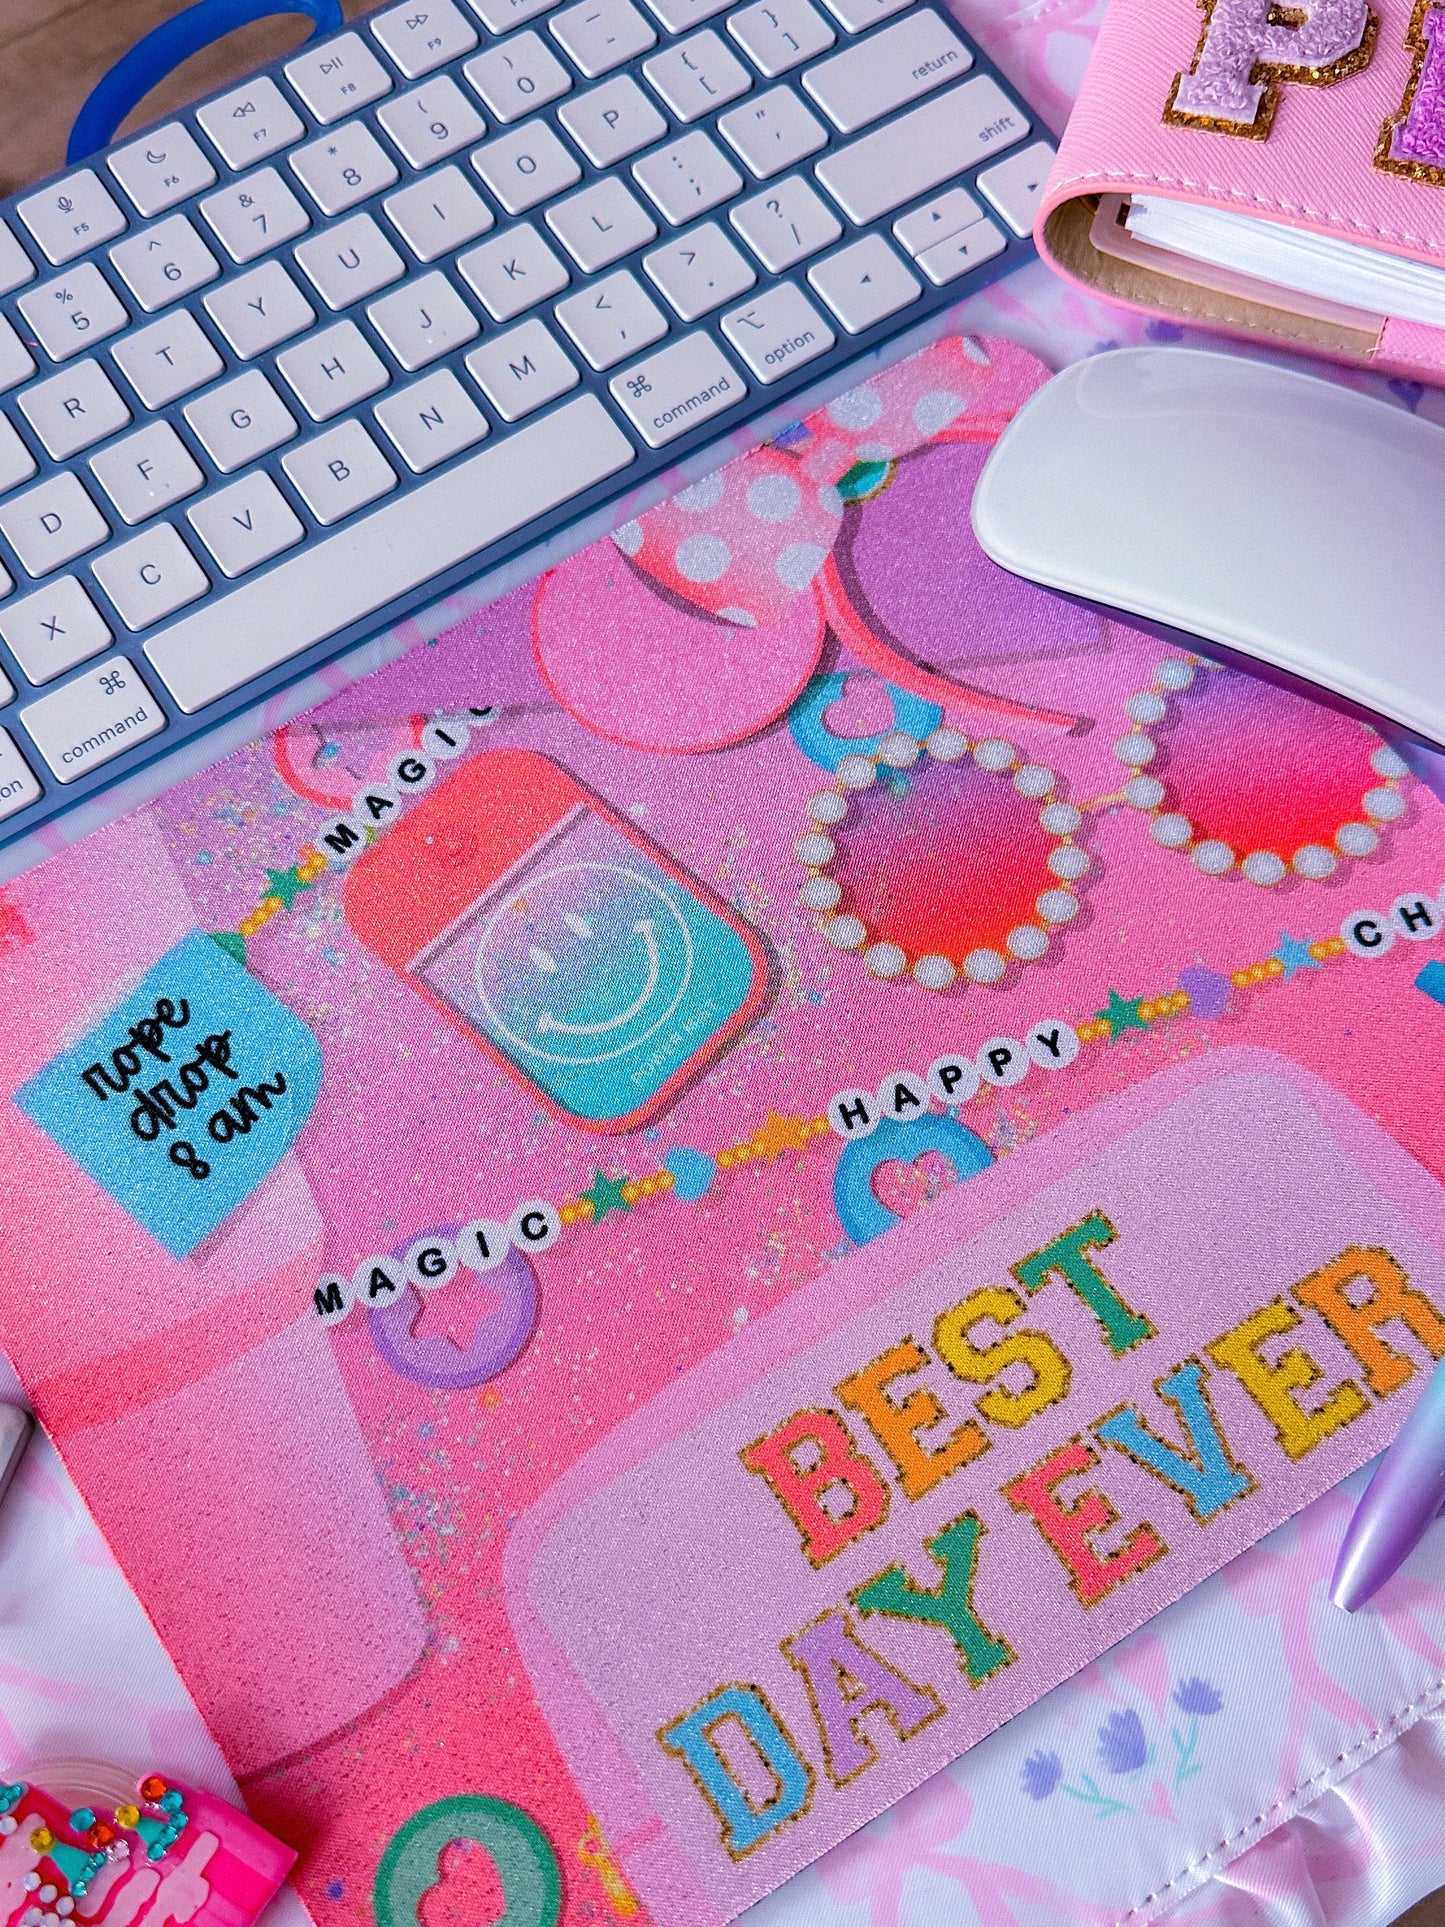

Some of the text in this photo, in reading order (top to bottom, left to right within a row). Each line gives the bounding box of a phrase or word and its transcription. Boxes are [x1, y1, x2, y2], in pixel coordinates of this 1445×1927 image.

[761, 9, 779, 28] }
[428, 38, 441, 49] F9
[782, 32, 800, 51] ]
[681, 51, 698, 71] {
[911, 48, 959, 81] return
[341, 83, 356, 94] F8
[698, 76, 717, 95] [
[602, 109, 620, 130] P
[979, 116, 1015, 143] shift
[253, 129, 266, 140] F7
[430, 122, 449, 140] 9
[516, 155, 537, 175] O
[164, 176, 179, 187] F6
[342, 168, 362, 186] 8
[238, 194, 255, 208] &
[432, 203, 446, 220] I
[766, 199, 783, 218] ?
[74, 223, 89, 235] F5
[252, 214, 267, 234] 7
[591, 216, 614, 233] L
[790, 221, 802, 247] /
[337, 248, 361, 270] U
[679, 249, 697, 266] >
[163, 262, 182, 281] 6
[502, 259, 526, 281] K
[55, 288, 74, 305] %
[247, 296, 266, 317] Y
[595, 295, 612, 309] <
[71, 311, 90, 331] 5
[420, 308, 432, 329] J
[155, 346, 174, 366] T
[764, 330, 816, 366] option
[320, 357, 346, 381] H
[508, 355, 537, 381] M
[63, 397, 86, 419] R
[653, 377, 731, 430] command
[230, 409, 252, 429] G
[419, 406, 444, 431] N
[136, 459, 153, 481] F
[327, 459, 351, 482] B
[39, 512, 62, 535] D
[232, 509, 253, 531] V
[140, 564, 162, 585] C
[40, 615, 66, 641] X
[62, 707, 148, 764] command
[130, 1029, 239, 1142] drop
[838, 1029, 1061, 1130] HAPPY
[169, 1071, 287, 1180] 8 am
[313, 1211, 549, 1316] MAGIC
[738, 1208, 1160, 1570] BEST
[655, 1243, 1445, 1863] DAY EVER
